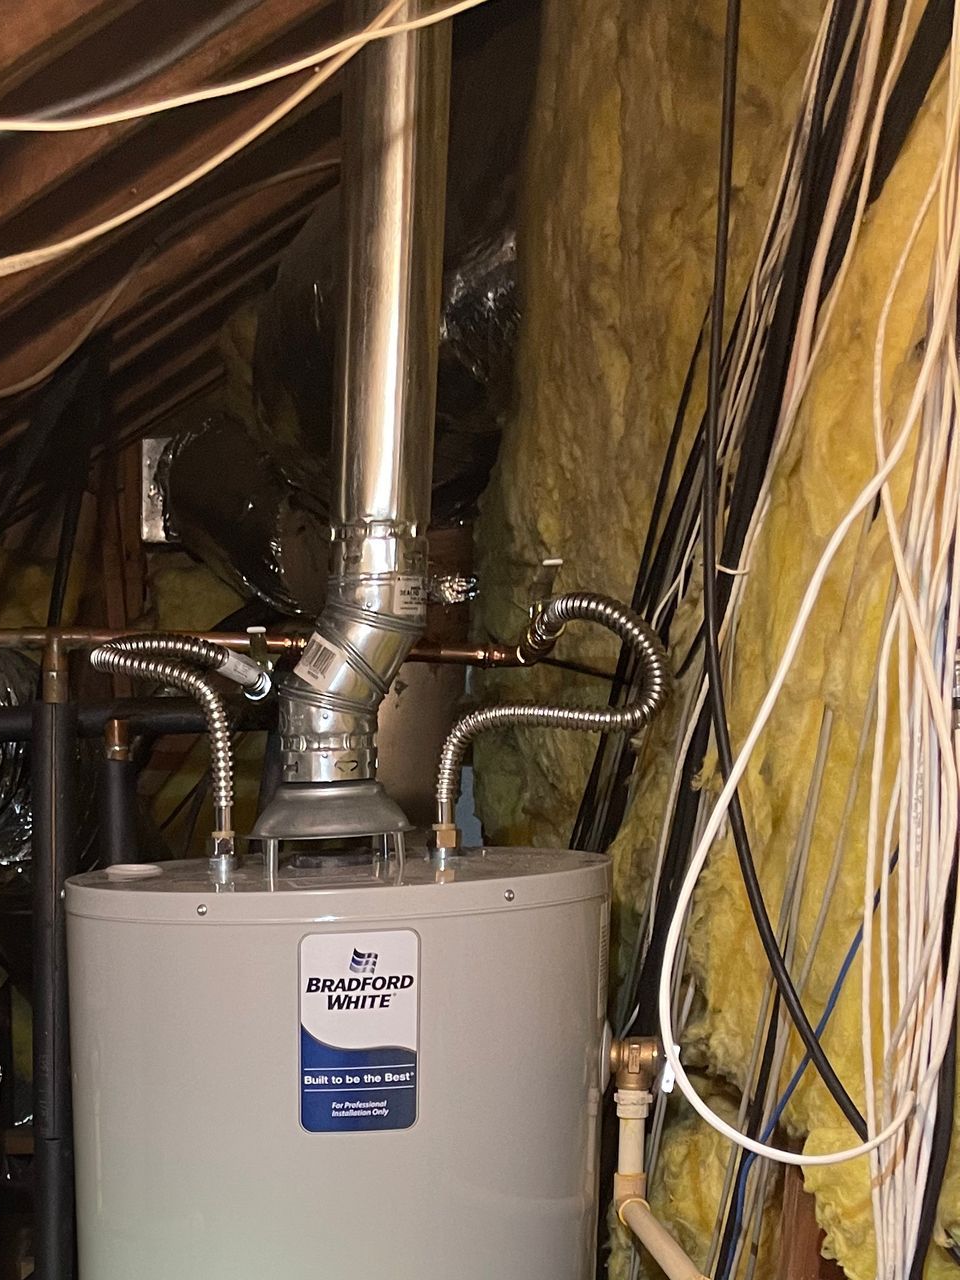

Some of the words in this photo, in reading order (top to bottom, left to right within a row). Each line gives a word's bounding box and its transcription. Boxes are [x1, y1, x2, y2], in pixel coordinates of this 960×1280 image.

[306, 975, 414, 993] BRADFORD
[327, 994, 392, 1010] WHITE
[304, 1076, 329, 1085] Built
[331, 1076, 343, 1084] to
[345, 1075, 361, 1084] be
[364, 1074, 382, 1083] the
